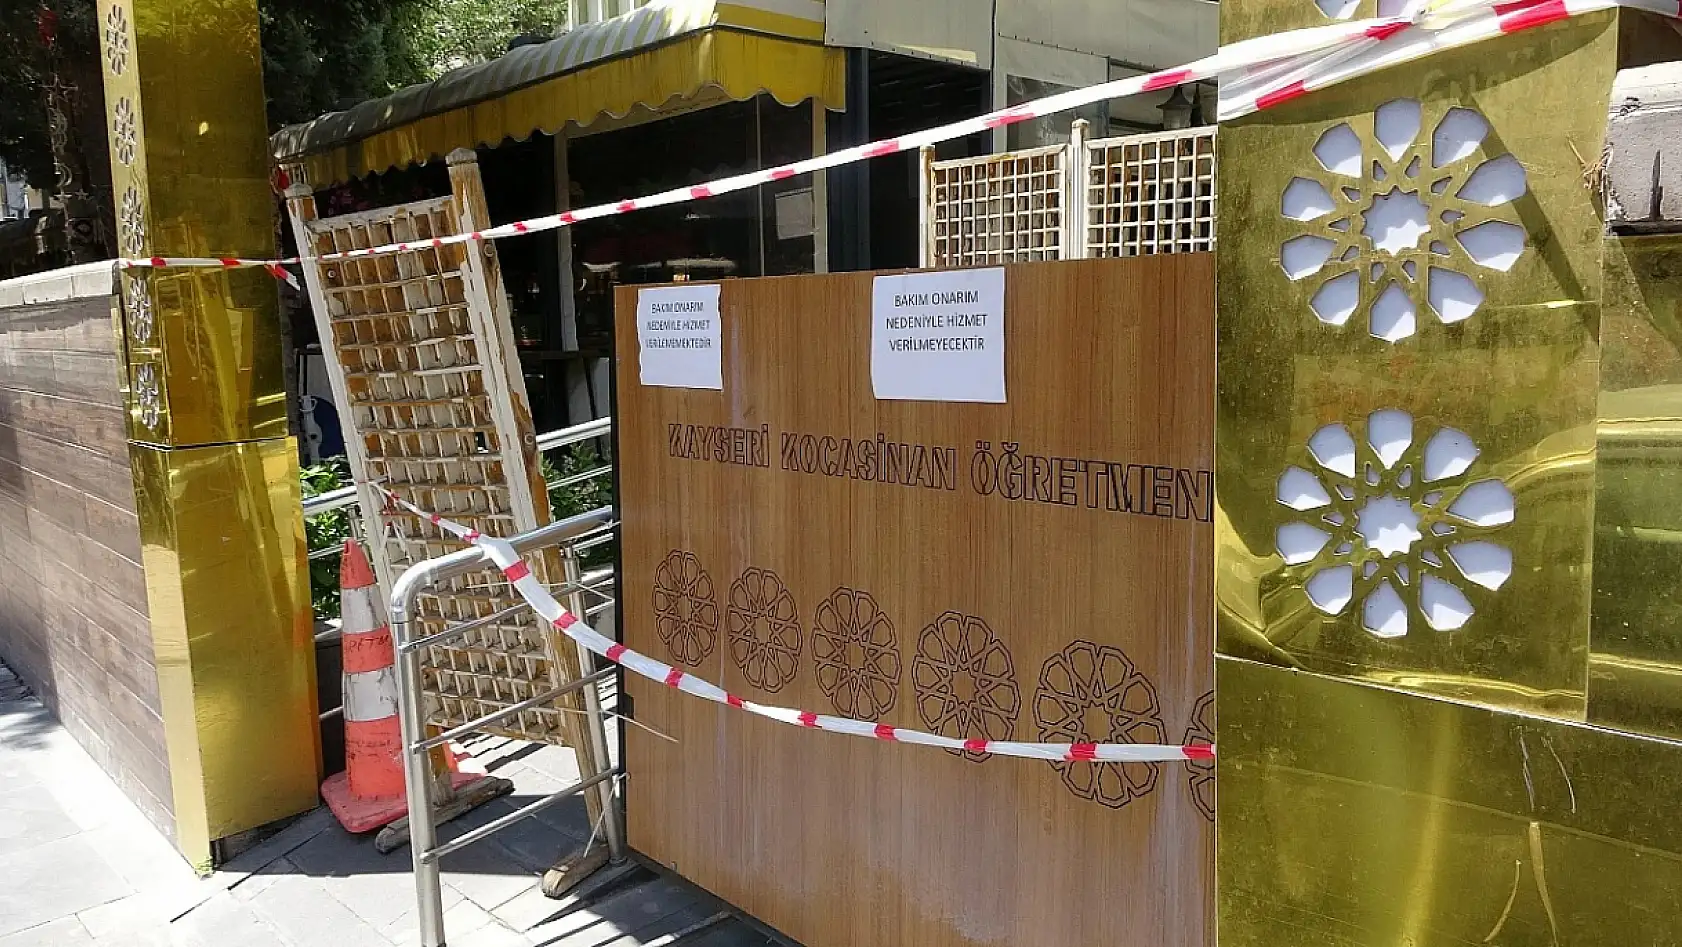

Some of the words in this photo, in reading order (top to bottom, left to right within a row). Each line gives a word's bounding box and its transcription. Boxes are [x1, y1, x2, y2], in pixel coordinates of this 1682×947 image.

[894, 293, 928, 307] BAKIM
[931, 290, 979, 305] ONARIM
[886, 314, 944, 330] NEDENİYLE
[947, 312, 988, 327] HİZMET
[889, 335, 985, 351] VERİLMEYECEKTİR
[668, 423, 770, 467] KAYSERİ
[781, 432, 957, 490] KOCASİNAN
[970, 440, 1214, 522] ÖĞRETMEN
